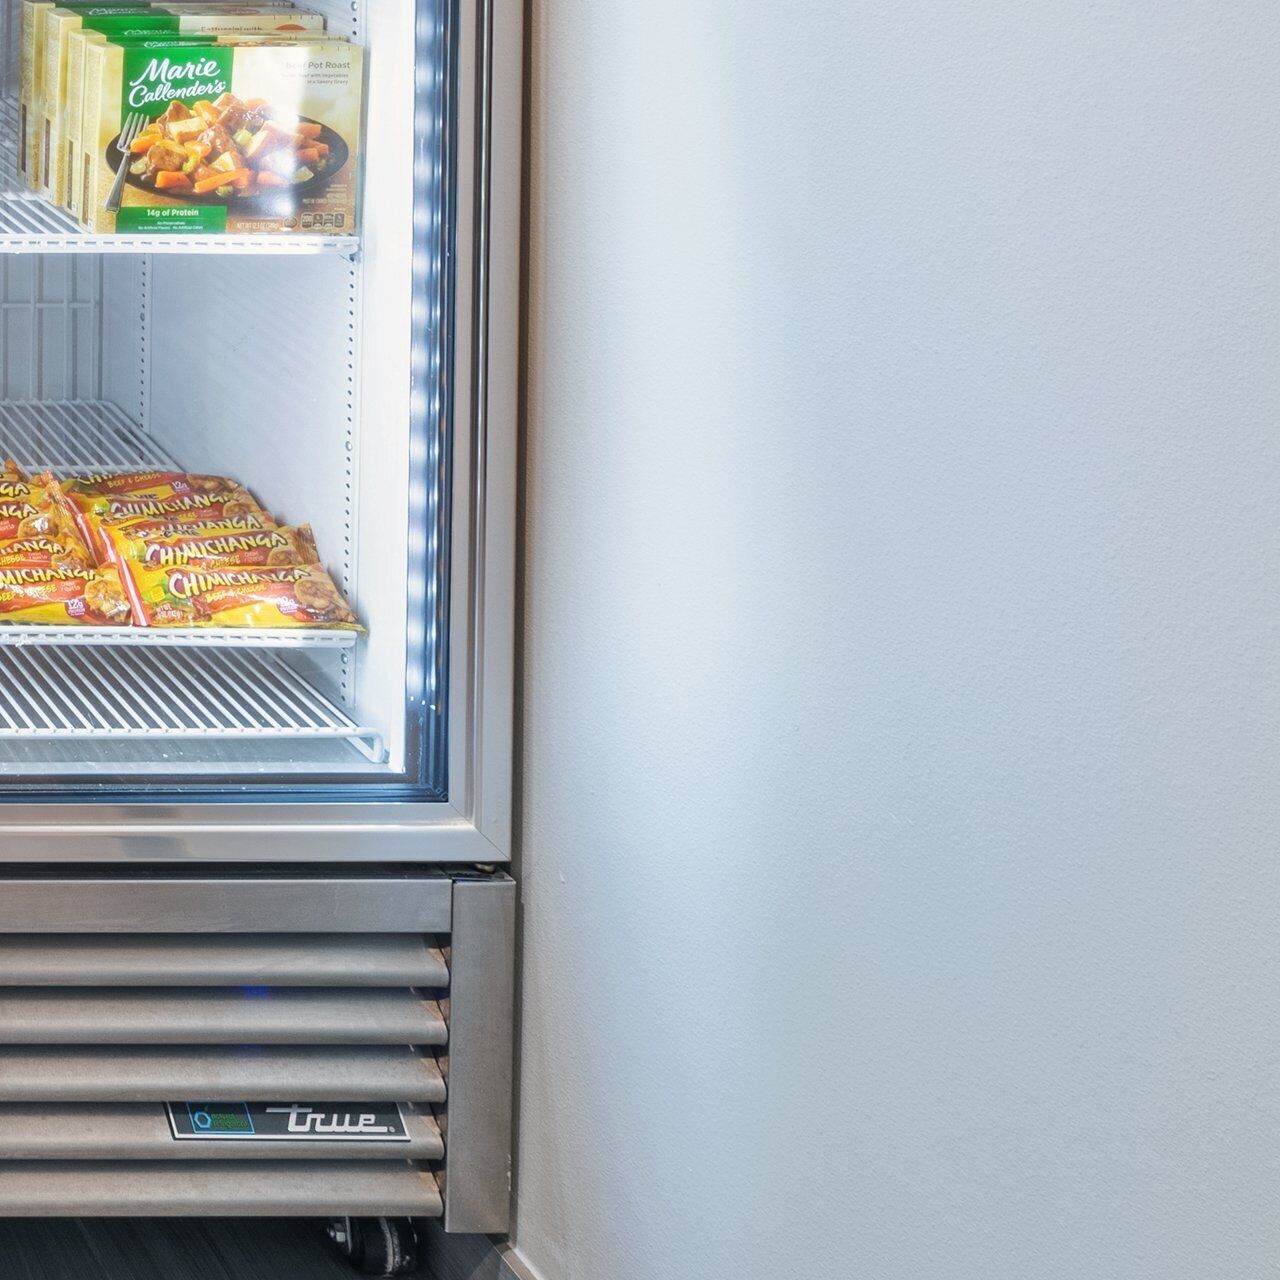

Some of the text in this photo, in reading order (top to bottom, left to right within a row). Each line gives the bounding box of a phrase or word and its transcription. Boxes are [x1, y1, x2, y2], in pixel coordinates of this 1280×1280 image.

[129, 58, 221, 87] Marie
[308, 61, 350, 69] Pot Roast
[128, 80, 226, 109] Callender's
[147, 209, 160, 217] 14g
[171, 209, 199, 217] Protein
[172, 481, 189, 490] 12g
[168, 568, 311, 599] CHIMICHANGA
[67, 599, 84, 609] 12g
[266, 1103, 388, 1132] true
